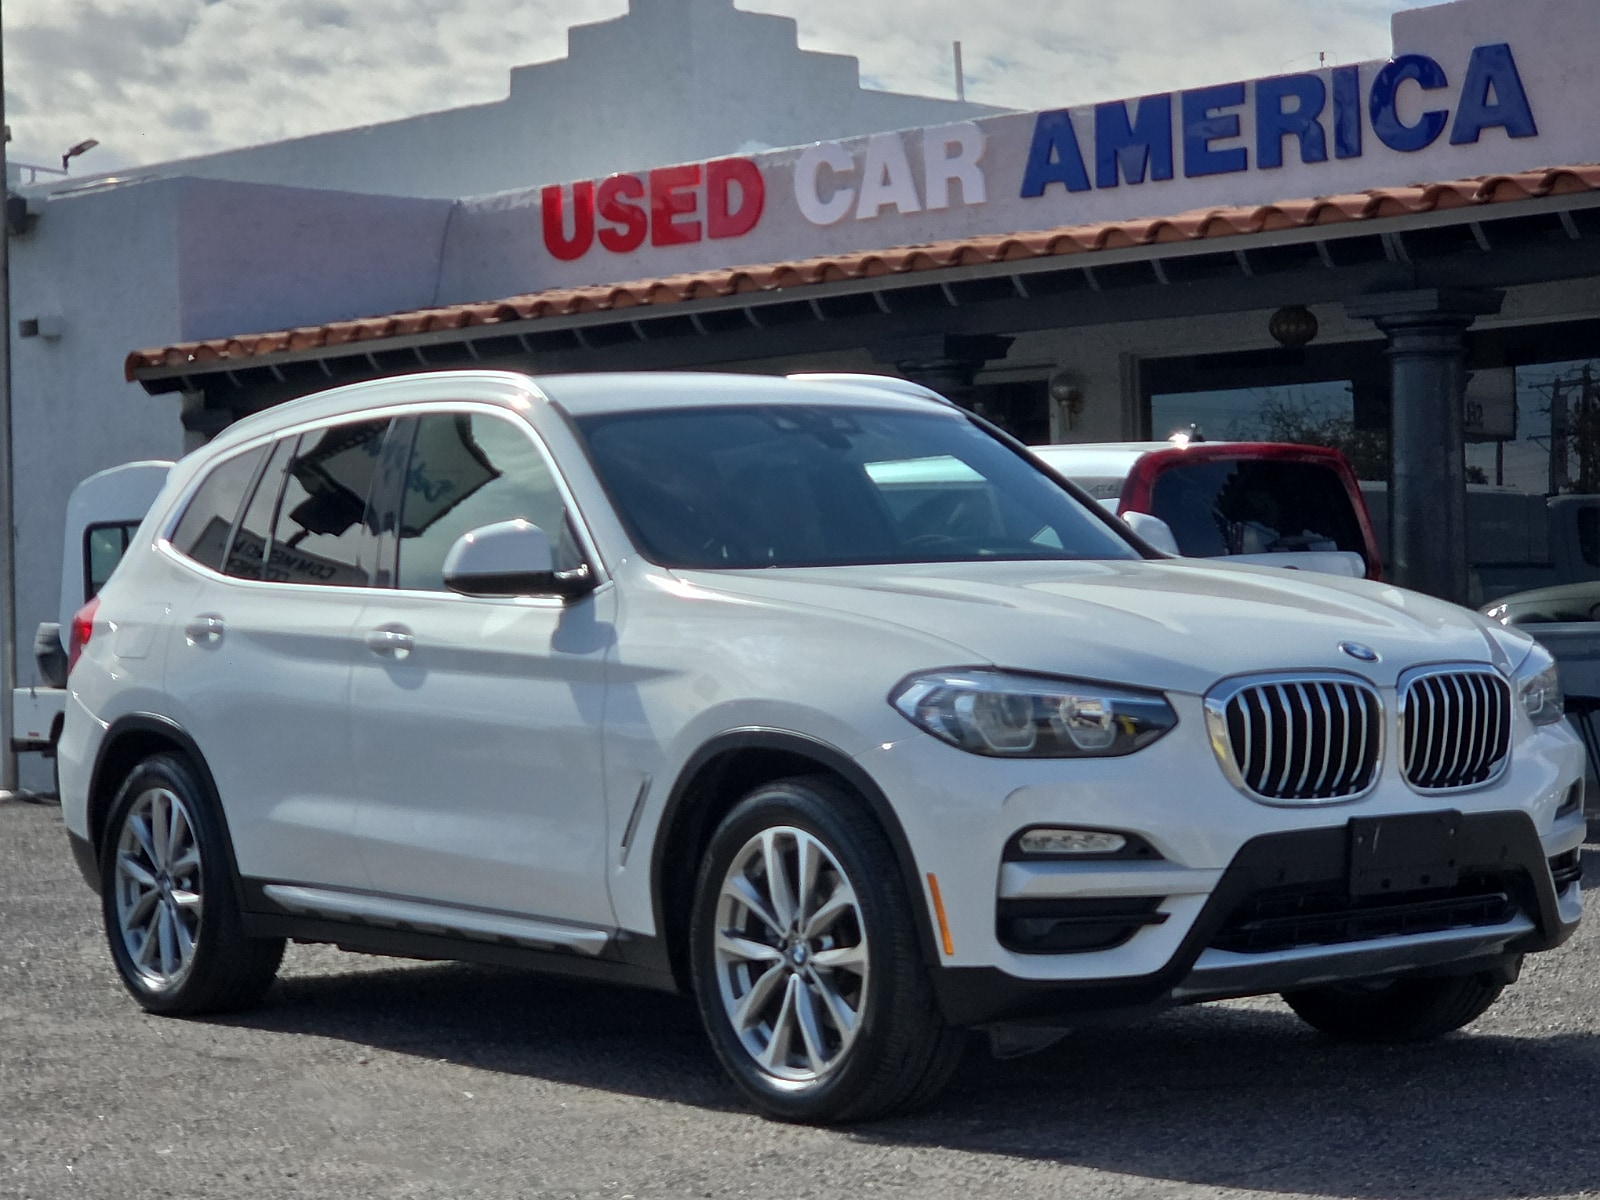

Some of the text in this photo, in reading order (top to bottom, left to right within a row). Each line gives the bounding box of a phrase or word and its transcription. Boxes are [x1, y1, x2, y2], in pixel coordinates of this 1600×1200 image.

[541, 42, 1539, 261] USED CAR AMERICA
